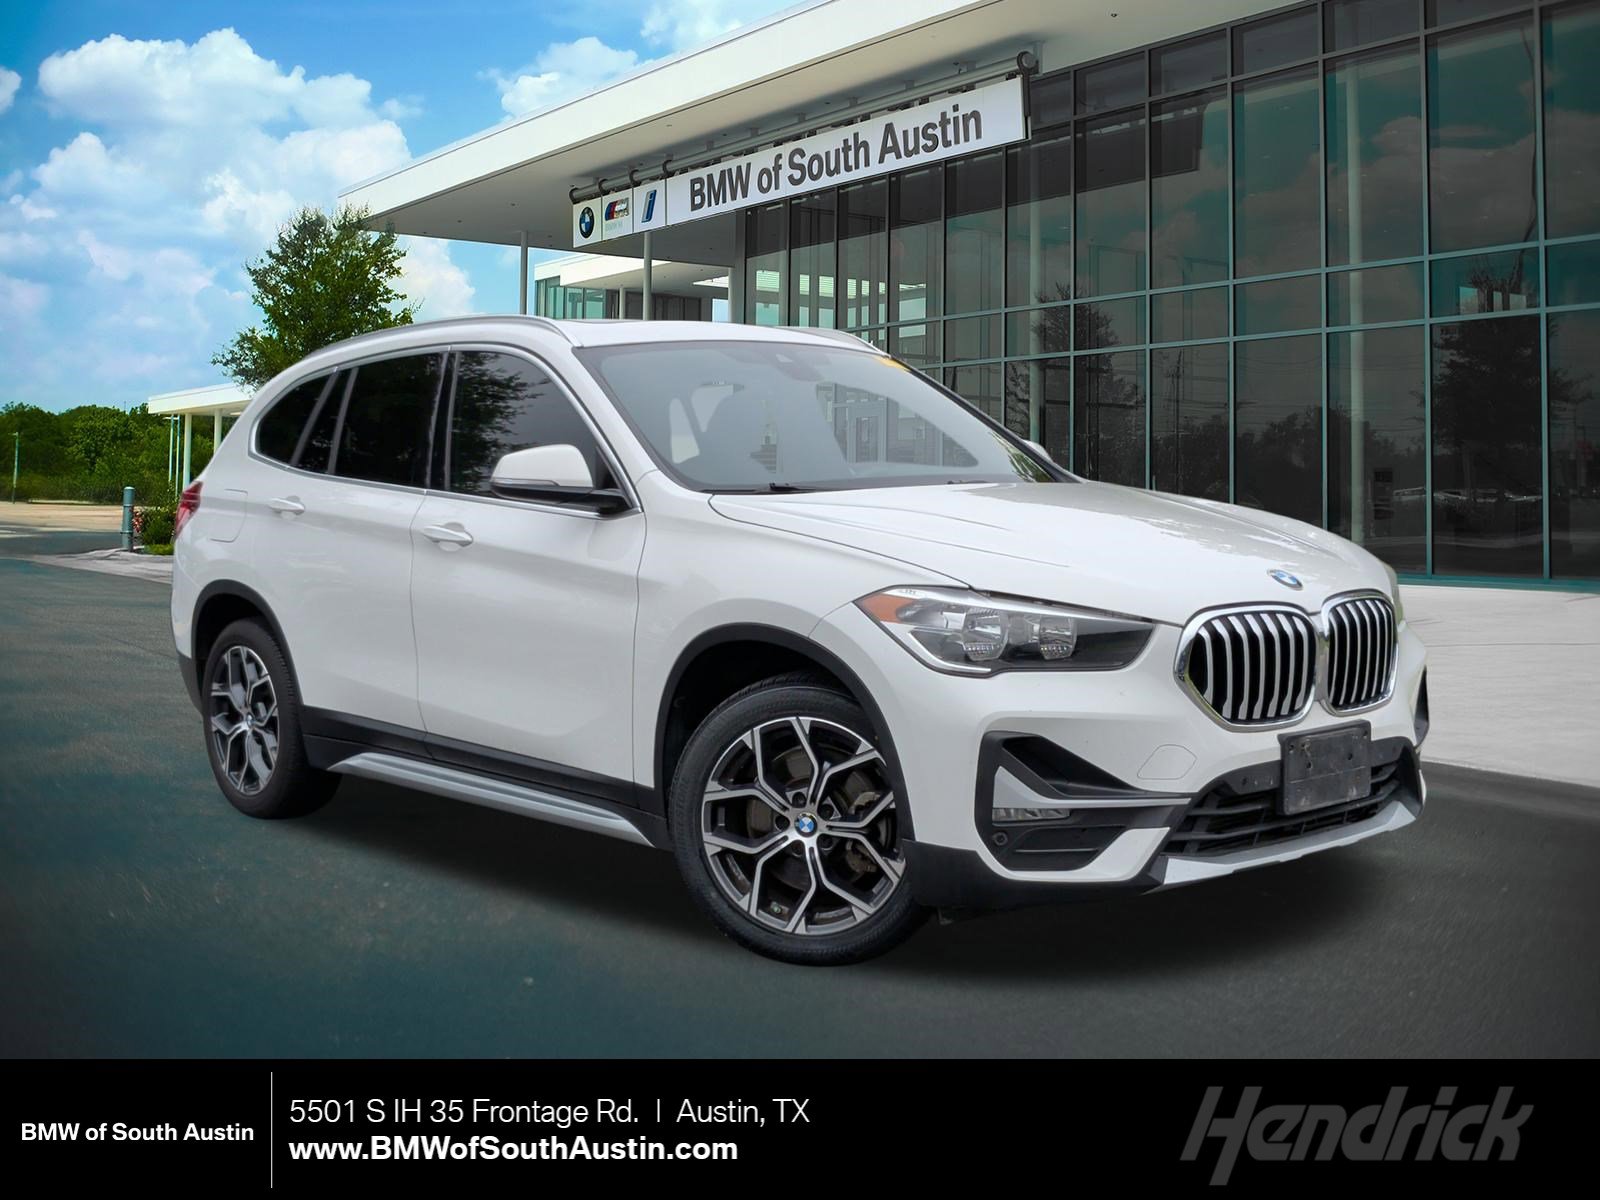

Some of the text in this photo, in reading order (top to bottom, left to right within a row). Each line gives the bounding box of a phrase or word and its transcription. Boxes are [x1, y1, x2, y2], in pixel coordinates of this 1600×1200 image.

[690, 104, 982, 212] BMW of South Austin
